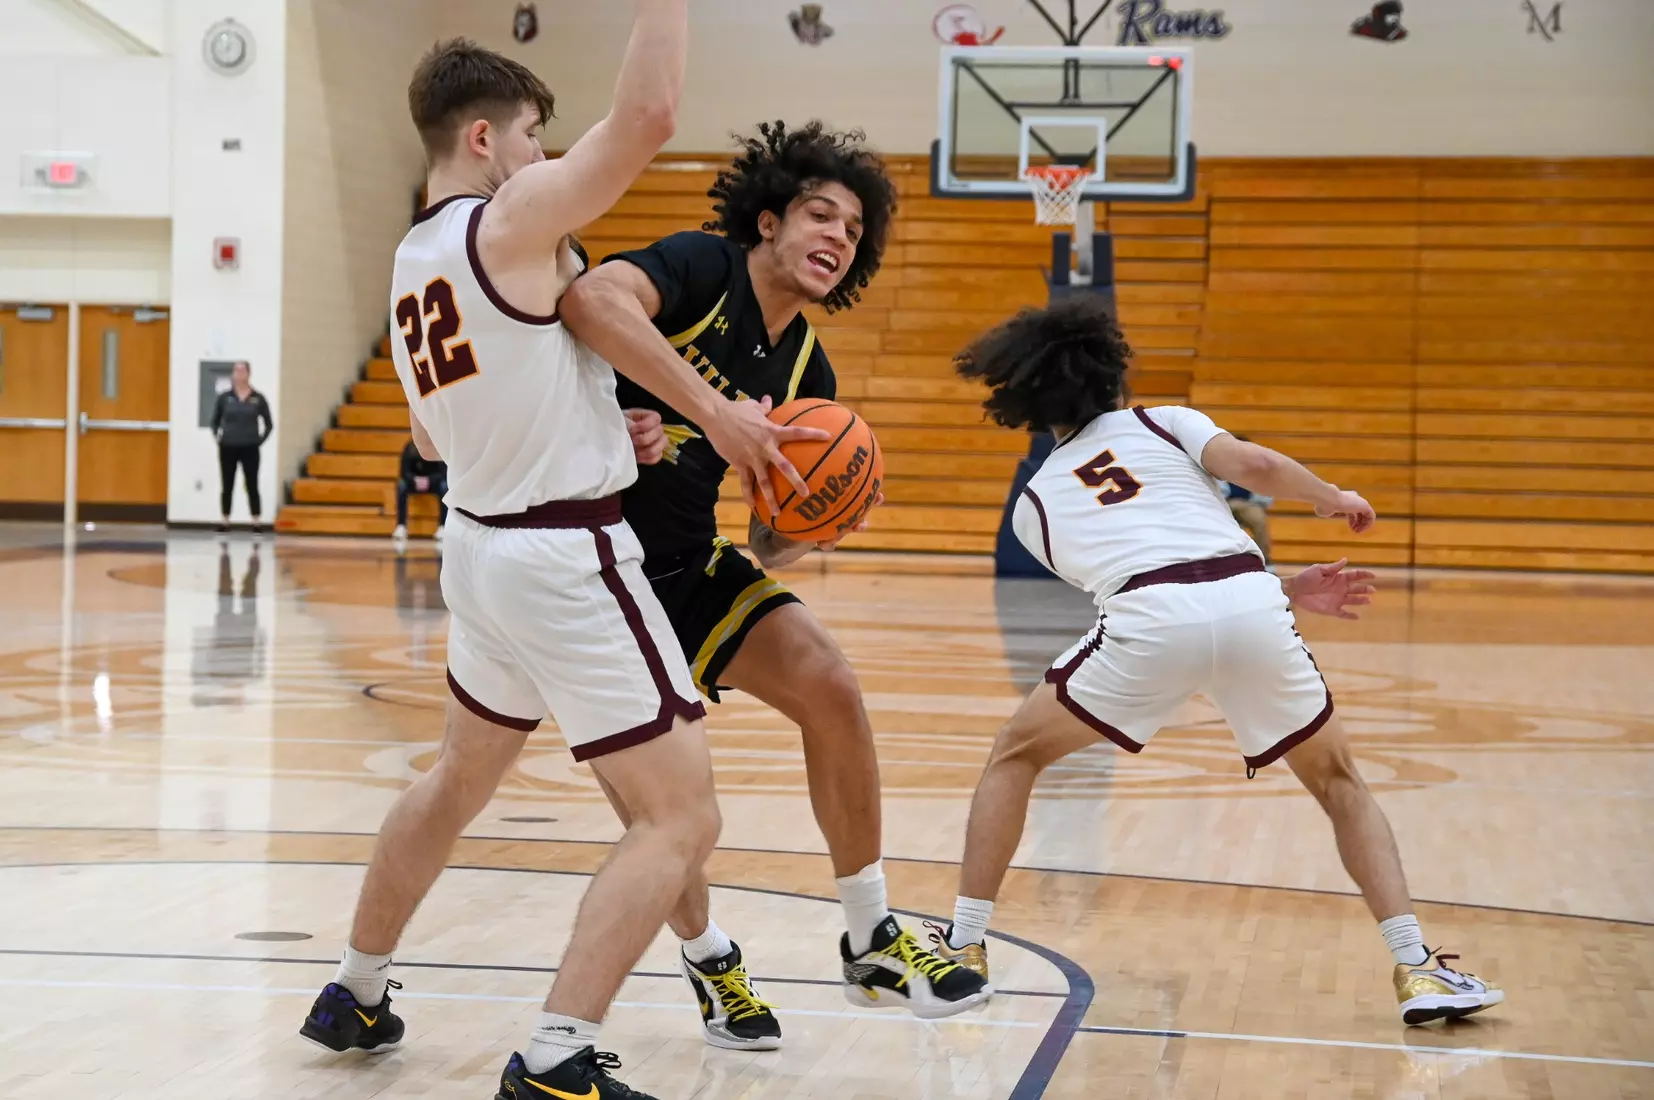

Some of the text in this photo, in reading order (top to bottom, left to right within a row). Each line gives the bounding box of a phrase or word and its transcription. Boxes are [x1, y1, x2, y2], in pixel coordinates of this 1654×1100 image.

[1115, 0, 1232, 45] Rams
[395, 275, 480, 400] 22
[793, 445, 868, 521] Wilson
[1072, 447, 1144, 507] 5
